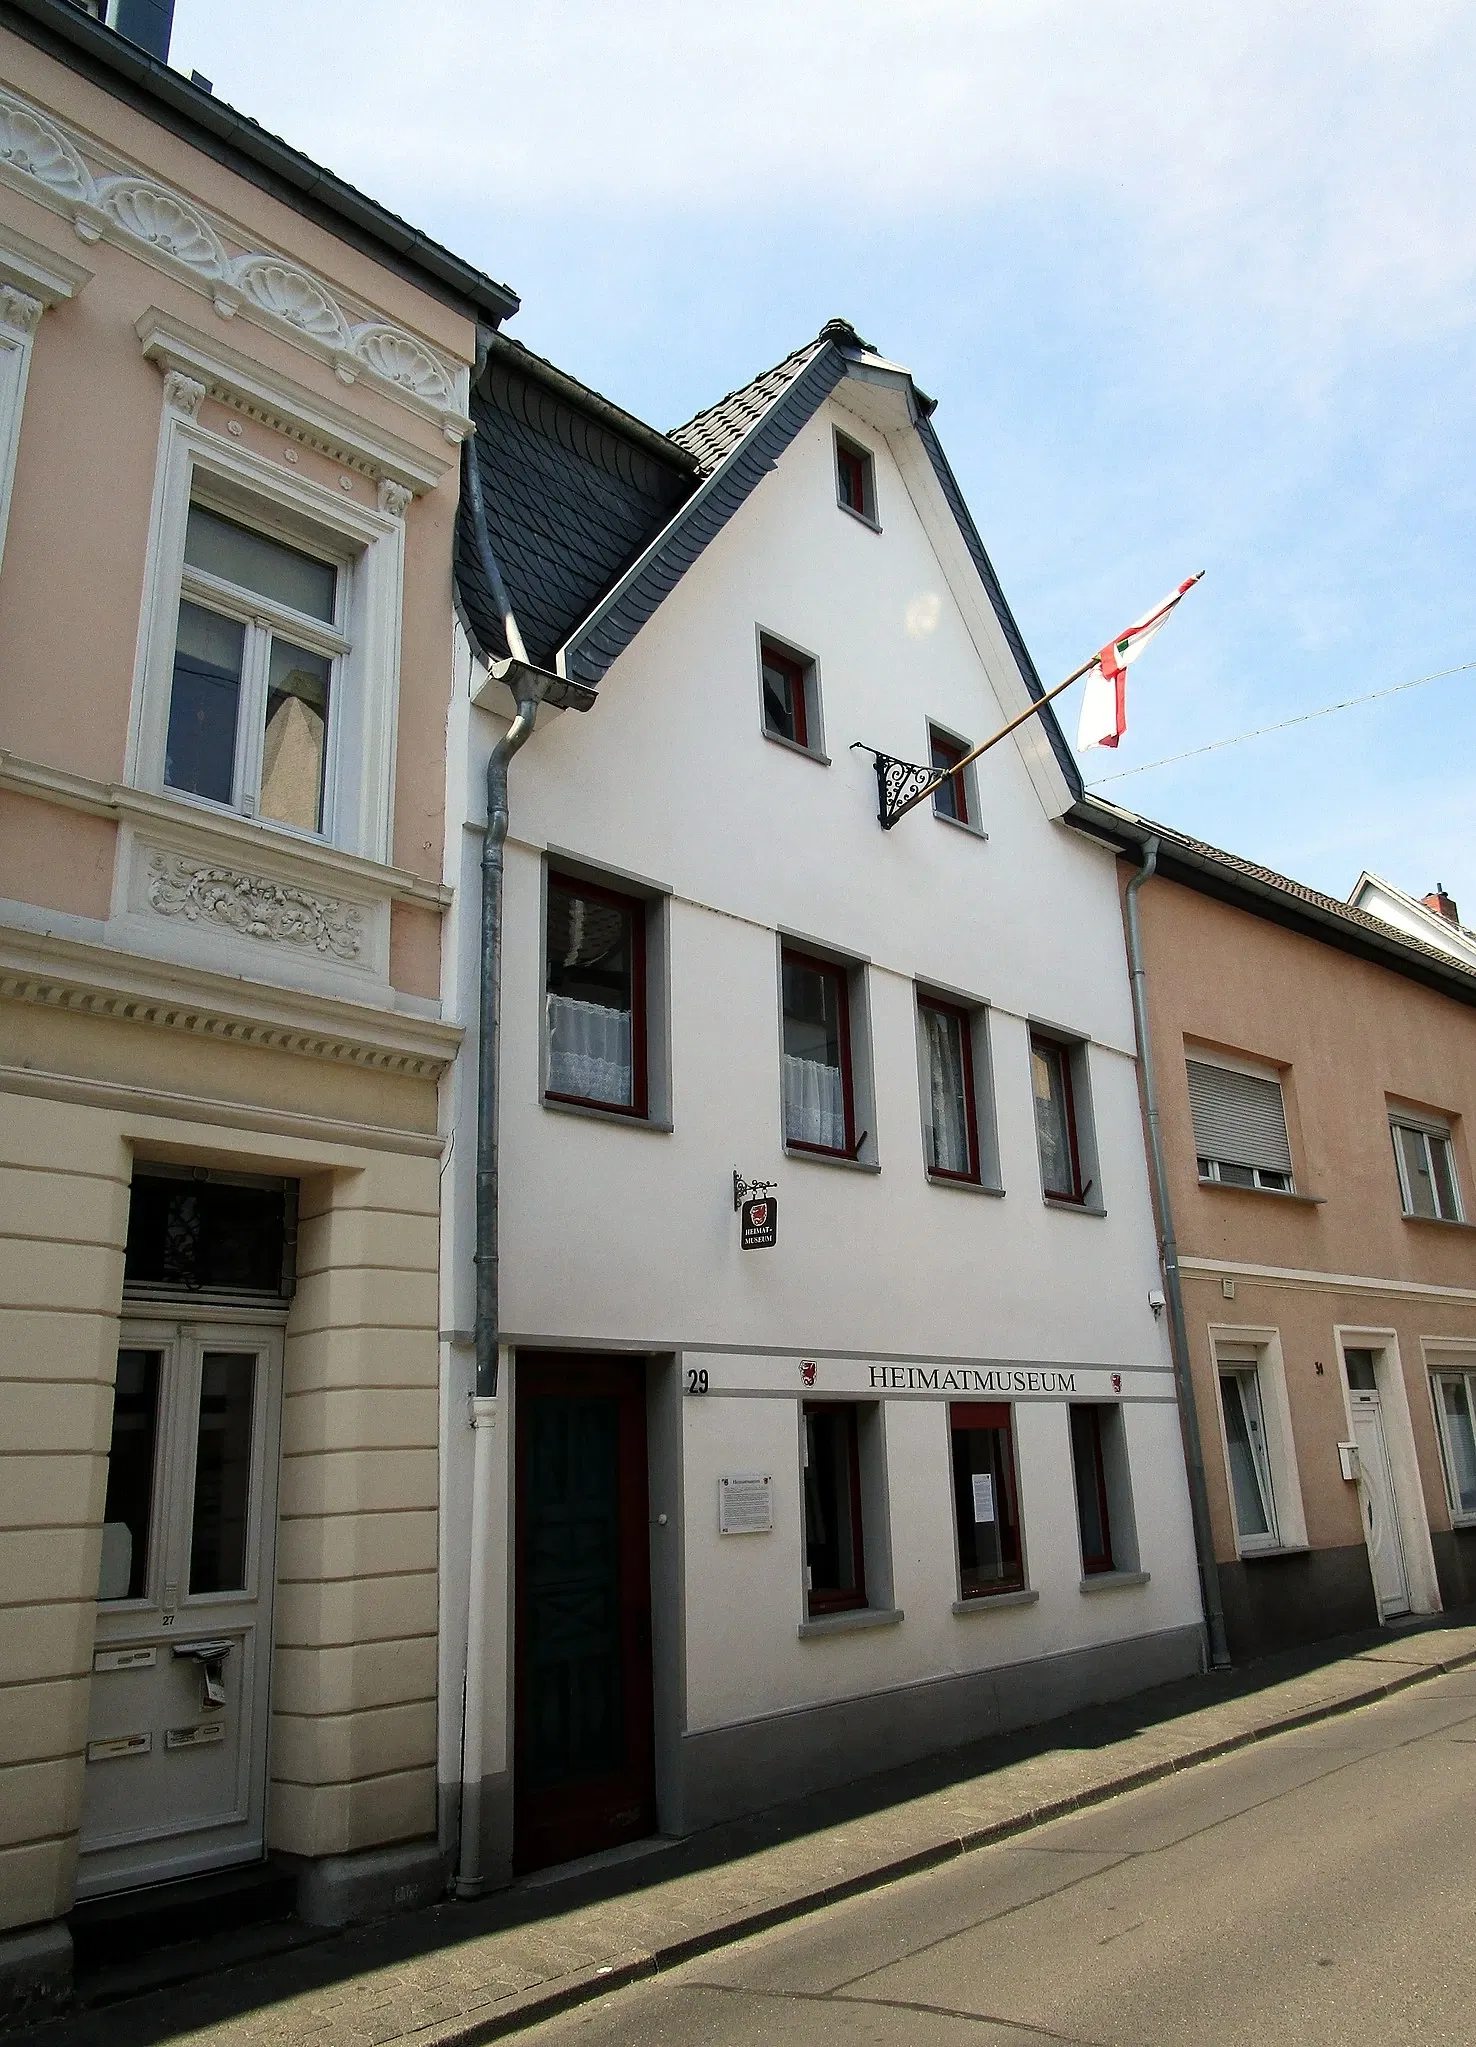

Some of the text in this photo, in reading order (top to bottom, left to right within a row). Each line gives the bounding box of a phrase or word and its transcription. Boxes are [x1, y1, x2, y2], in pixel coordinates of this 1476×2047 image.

[745, 1226, 773, 1236] HEIMAT-
[745, 1235, 772, 1245] MUSEUM
[688, 1369, 708, 1393] 29
[868, 1365, 1076, 1392] HEIMATMUSEUM
[162, 1615, 175, 1626] 27
